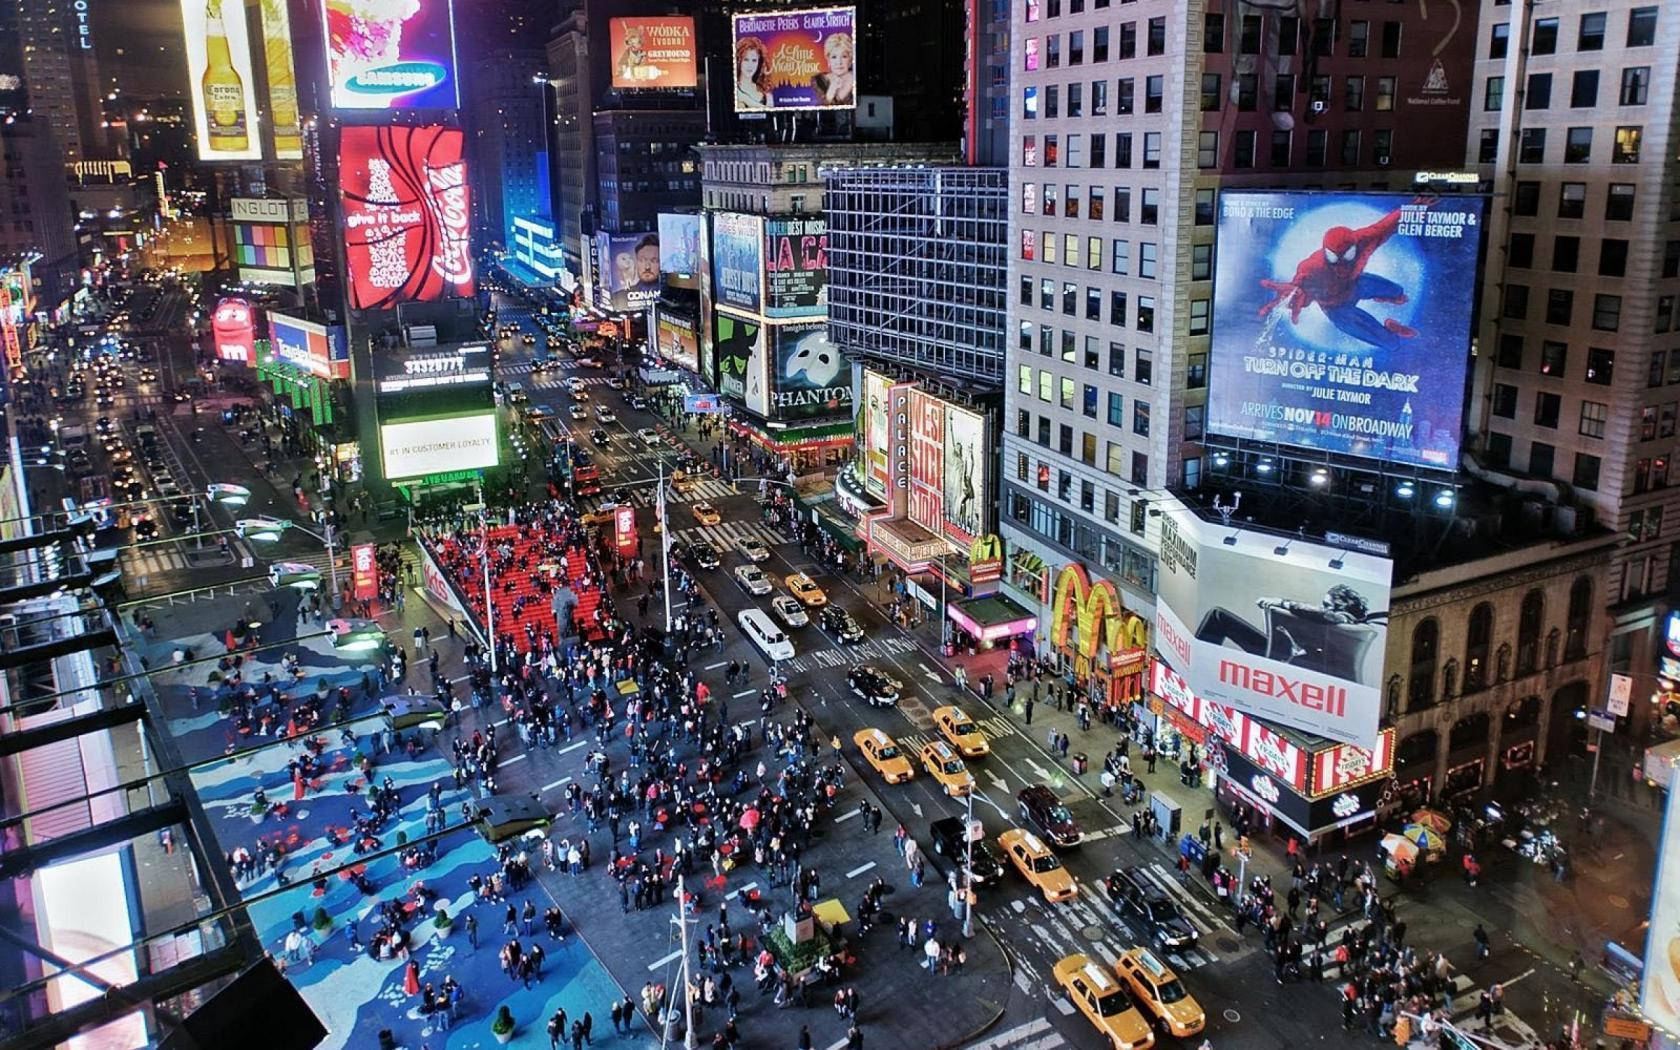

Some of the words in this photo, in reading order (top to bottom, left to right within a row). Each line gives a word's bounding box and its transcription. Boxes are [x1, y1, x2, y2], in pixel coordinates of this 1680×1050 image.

[740, 18, 776, 33] BERNADETTE
[777, 17, 800, 31] PETERS
[206, 84, 240, 95] Corona
[232, 201, 288, 216] INGLOT
[1256, 208, 1273, 218] THE
[1273, 208, 1295, 219] EDGE
[1399, 211, 1426, 224] JULIE
[1427, 211, 1467, 225] TAYMOR
[1468, 213, 1477, 225] &
[347, 213, 376, 228] give
[378, 211, 388, 223] it
[391, 211, 421, 224] back
[788, 221, 804, 236] BEST
[1398, 224, 1423, 237] GLEN
[1425, 225, 1464, 238] BERGER
[766, 236, 795, 271] LA
[782, 324, 805, 333] Tonight
[805, 323, 828, 332] belongs
[1269, 346, 1374, 369] SPIDER-MAN
[1243, 356, 1289, 378] TURN
[1290, 361, 1326, 381] OFF
[1327, 365, 1361, 386] THE
[1362, 369, 1420, 393] DARK
[1311, 387, 1334, 401] JULIE
[1336, 389, 1371, 405] TAYMOR
[911, 391, 944, 445] WEST
[1241, 401, 1284, 421] ARRIVES
[1284, 408, 1316, 425] NOV
[1315, 411, 1332, 428] 14
[1332, 413, 1349, 430] ON
[1348, 415, 1414, 440] BROADWAY
[389, 447, 400, 456] #1
[401, 446, 411, 455] IN
[412, 441, 456, 454] CUSTOMER
[457, 438, 491, 449] LOYALTY
[897, 396, 907, 489] PALACE
[1161, 520, 1197, 568] MAXIMUM
[1160, 546, 1177, 574] LIVES
[1161, 536, 1196, 580] PERFORMANCE
[1157, 612, 1190, 666] maxell
[1219, 659, 1347, 717] maxell
